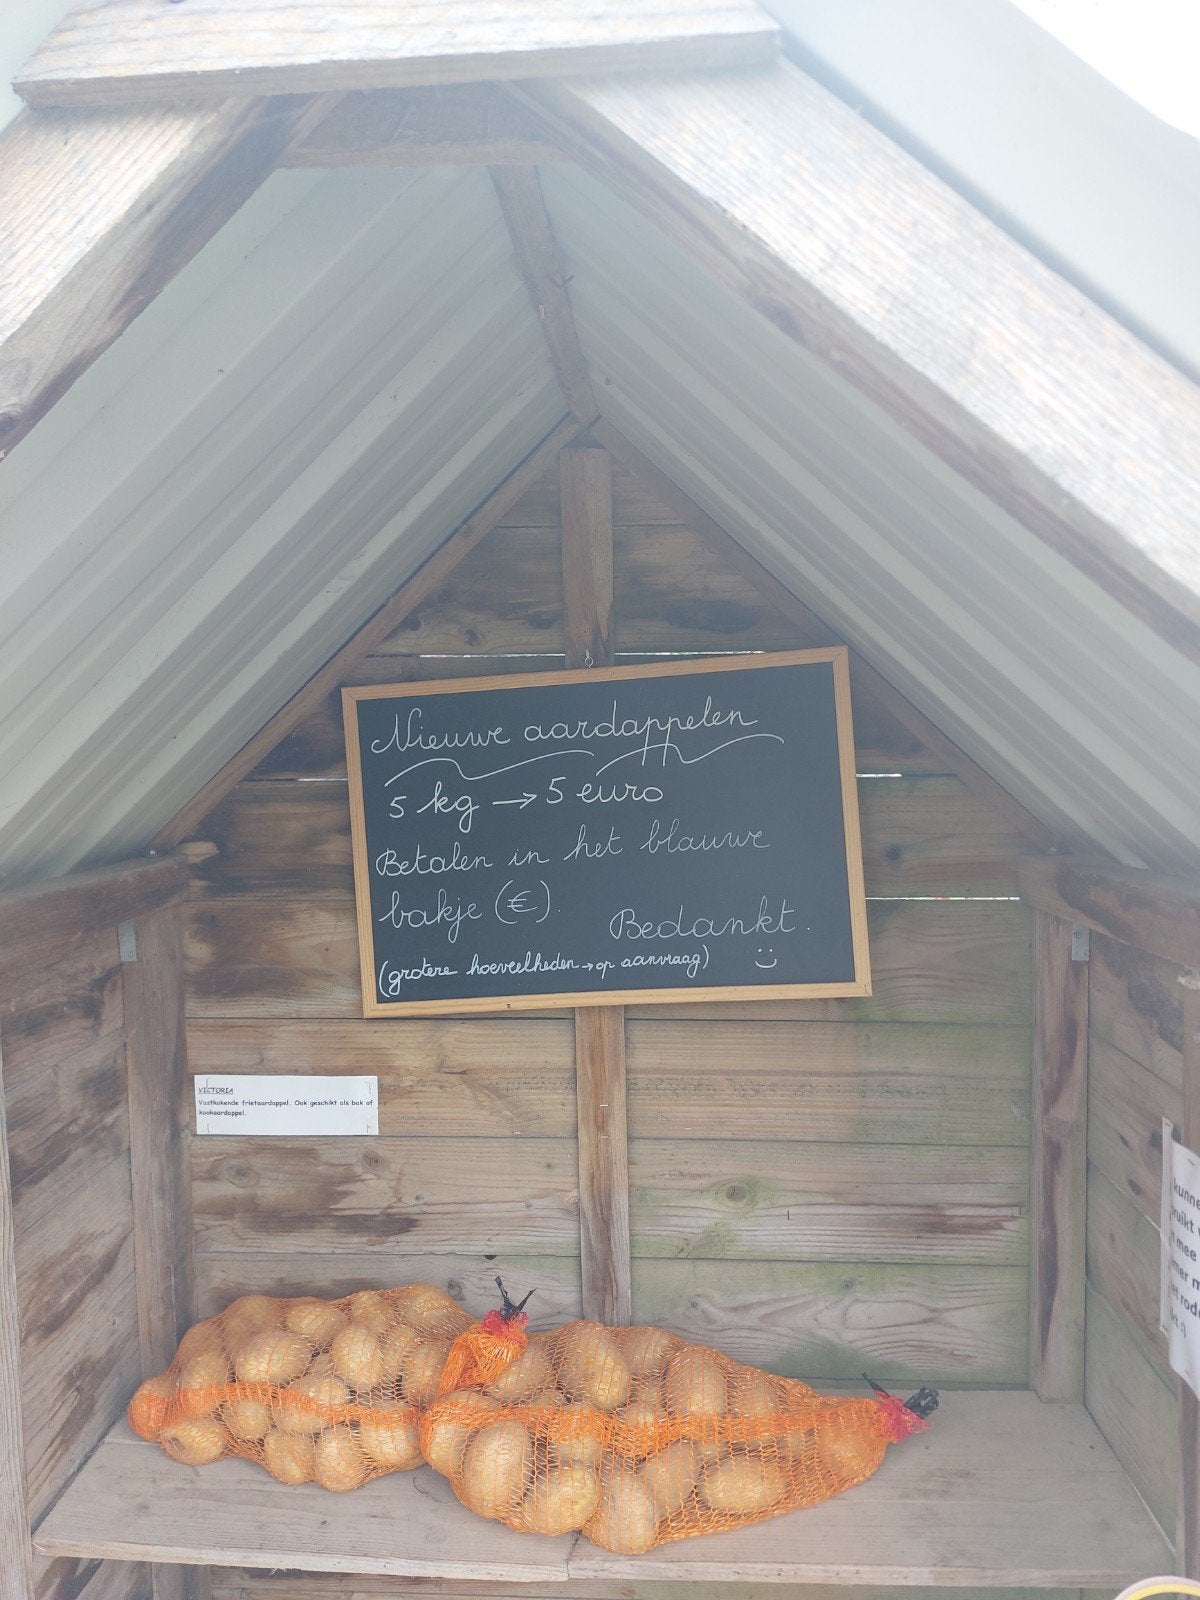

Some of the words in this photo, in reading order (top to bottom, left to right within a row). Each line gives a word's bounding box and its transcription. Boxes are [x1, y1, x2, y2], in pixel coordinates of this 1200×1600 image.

[371, 707, 511, 754] Nieuwe
[524, 695, 759, 767] aardappelen
[389, 796, 407, 819] 5
[416, 781, 480, 831] kg
[546, 776, 567, 804] 5
[576, 782, 664, 803] euro
[375, 842, 494, 876] Betalen
[508, 849, 550, 866] in
[563, 824, 623, 860] het
[639, 818, 770, 853] blauwe
[378, 888, 483, 943] bakje
[379, 960, 458, 998] (grotere
[466, 951, 580, 976] hoeveelheden
[596, 961, 615, 979] op
[620, 945, 710, 979] aanvraag)
[198, 1087, 234, 1095] VICTORIA
[309, 1099, 338, 1108] geschikt
